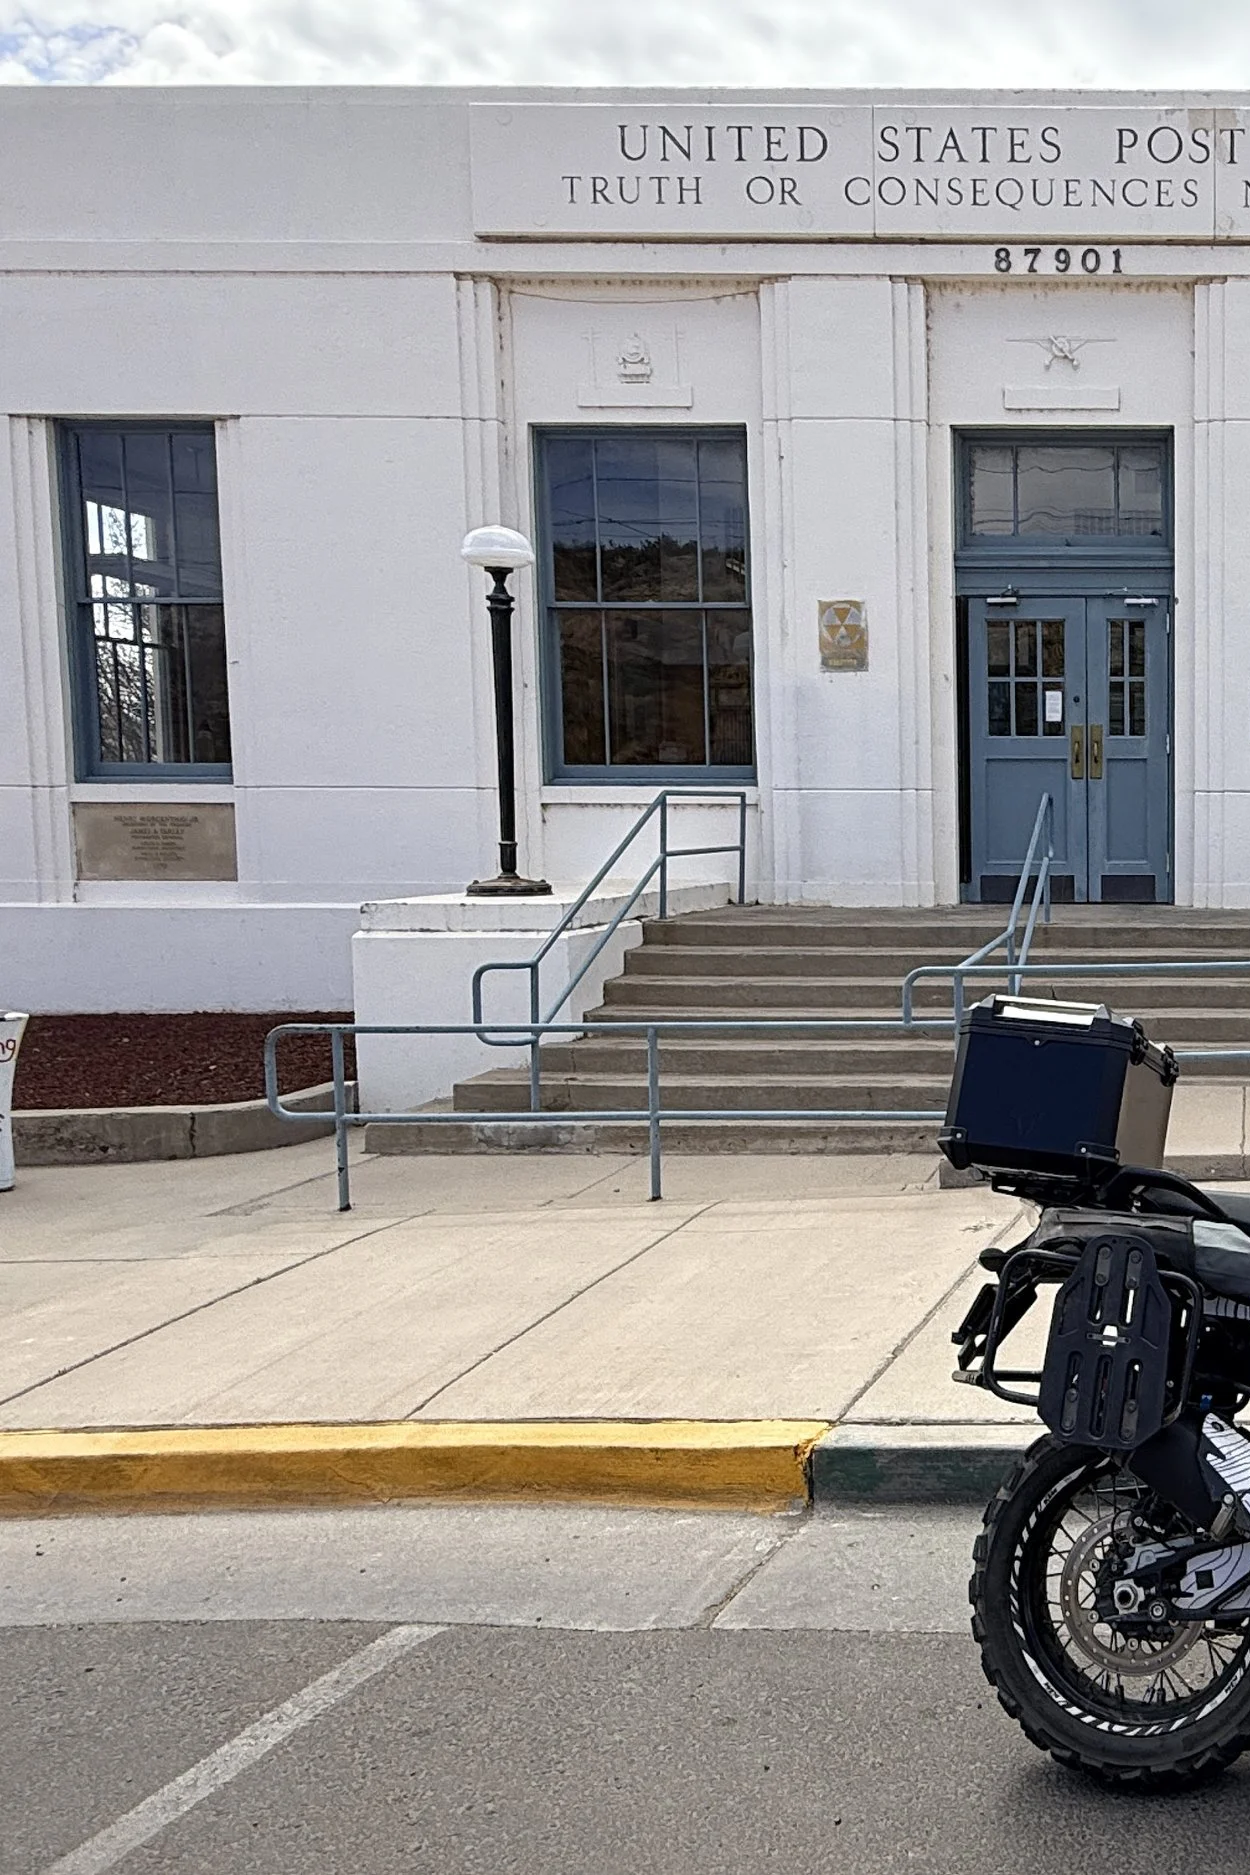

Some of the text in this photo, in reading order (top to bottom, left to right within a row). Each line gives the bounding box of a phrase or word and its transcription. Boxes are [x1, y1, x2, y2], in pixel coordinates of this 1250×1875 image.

[618, 125, 828, 162] UNITED
[877, 126, 1061, 163] STATES
[1115, 126, 1246, 165] POST
[562, 176, 703, 205] TRUTH
[746, 176, 802, 206] OR
[845, 176, 1200, 212] CONSEQUENCES
[994, 247, 1123, 274] 87901
